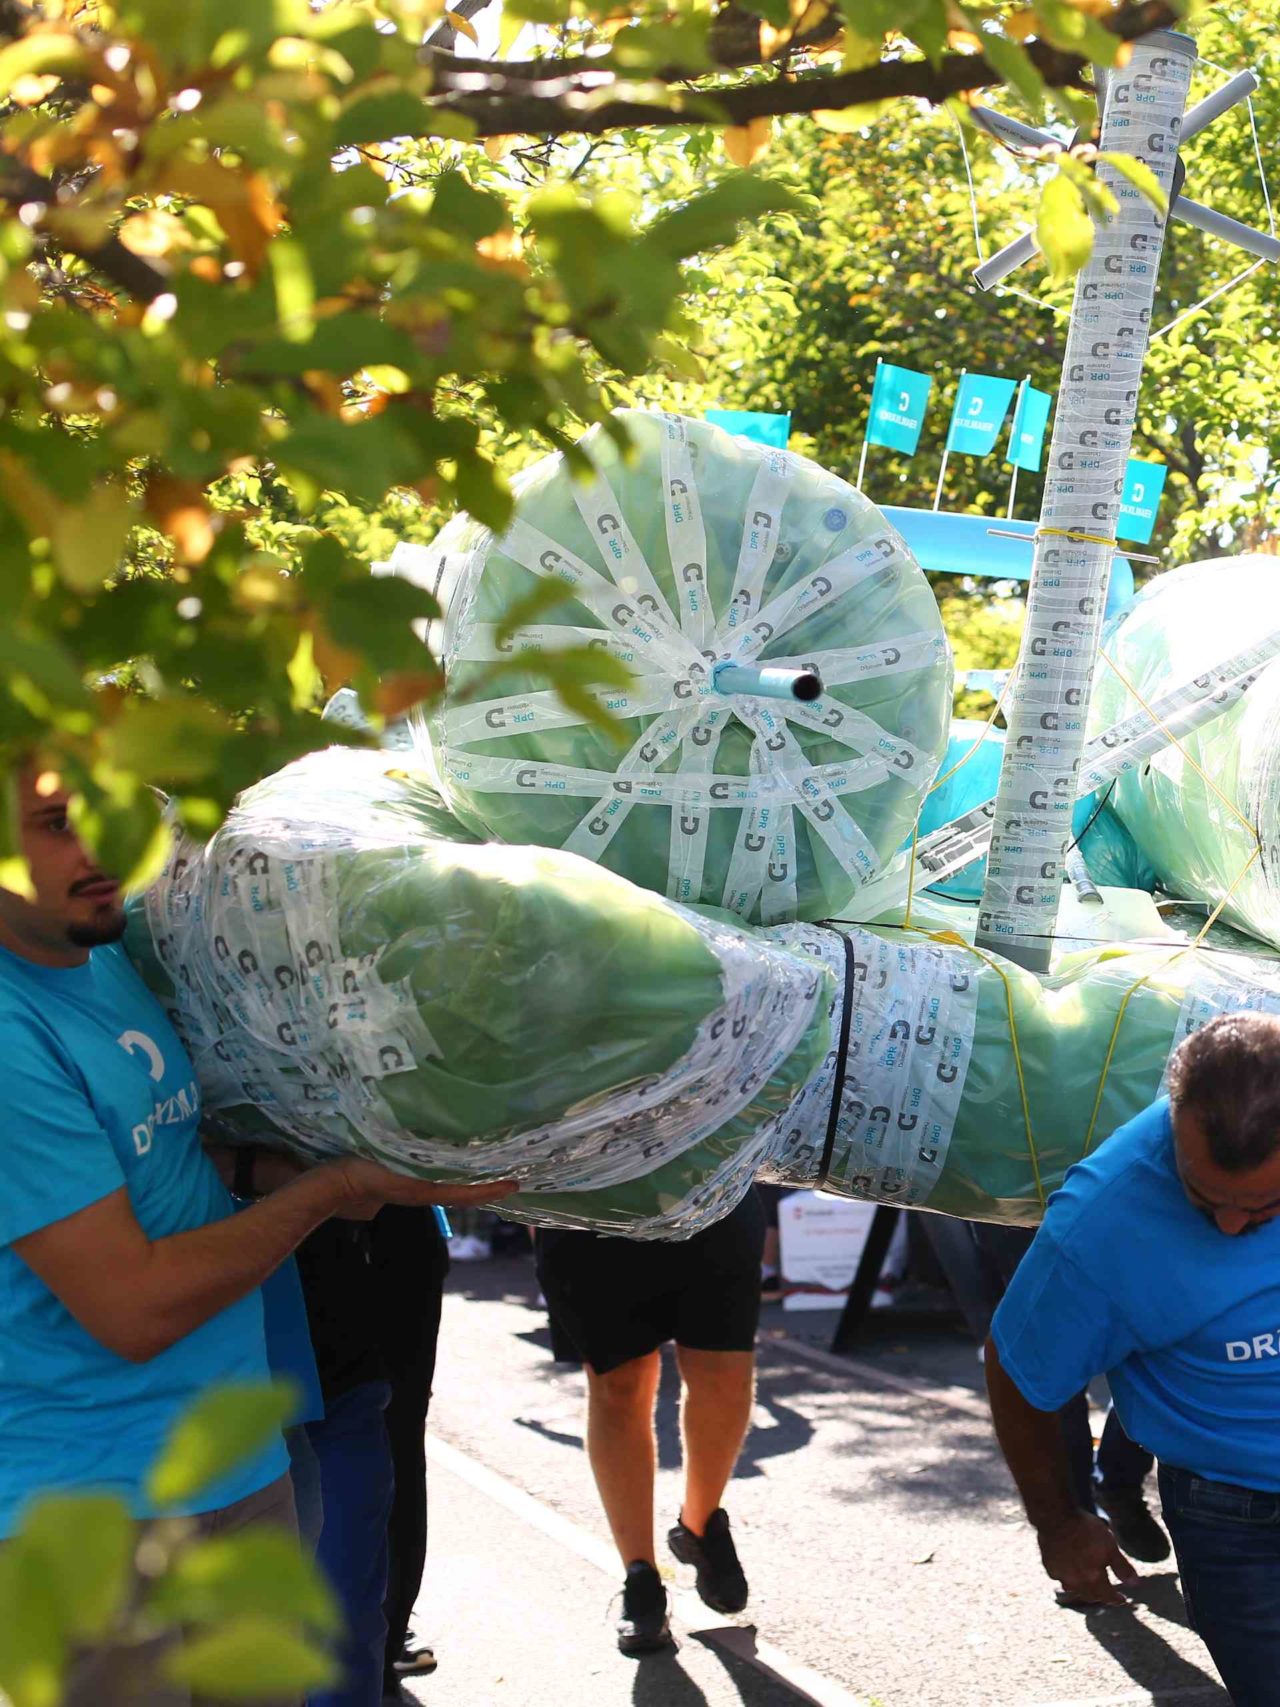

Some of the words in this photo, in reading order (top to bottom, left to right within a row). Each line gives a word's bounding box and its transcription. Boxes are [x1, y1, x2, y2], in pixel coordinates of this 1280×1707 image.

[1129, 265, 1147, 273] DPR
[1090, 373, 1110, 381] DPR
[1080, 460, 1100, 469] DPR
[1056, 485, 1074, 493] DPR
[673, 503, 683, 523] DPR
[608, 538, 622, 560] DPR
[751, 531, 760, 550] DPR
[855, 550, 873, 562] DPR
[689, 589, 698, 612] DPR
[727, 607, 739, 628] DPR
[632, 625, 653, 644] DPR
[1053, 648, 1073, 657] DPR
[606, 698, 628, 710] DPR
[806, 701, 823, 713] DPR
[513, 711, 535, 723] DPR
[760, 709, 775, 730] DPR
[1065, 722, 1080, 730] DPR
[878, 738, 897, 753] DPR
[803, 778, 819, 799] DPR
[826, 778, 848, 790] DPR
[606, 798, 623, 817] DPR
[758, 808, 770, 830] DPR
[776, 835, 785, 856] DPR
[855, 850, 873, 870] DPR
[682, 879, 691, 898] DPR
[250, 885, 265, 912] DPR
[995, 926, 1014, 935] DPR
[928, 998, 940, 1021] DPR
[885, 1045, 897, 1067] DPR
[951, 1037, 962, 1059] DPR
[910, 1087, 922, 1108] DPR
[864, 1126, 877, 1146] DPR
[930, 1124, 942, 1145] DPR
